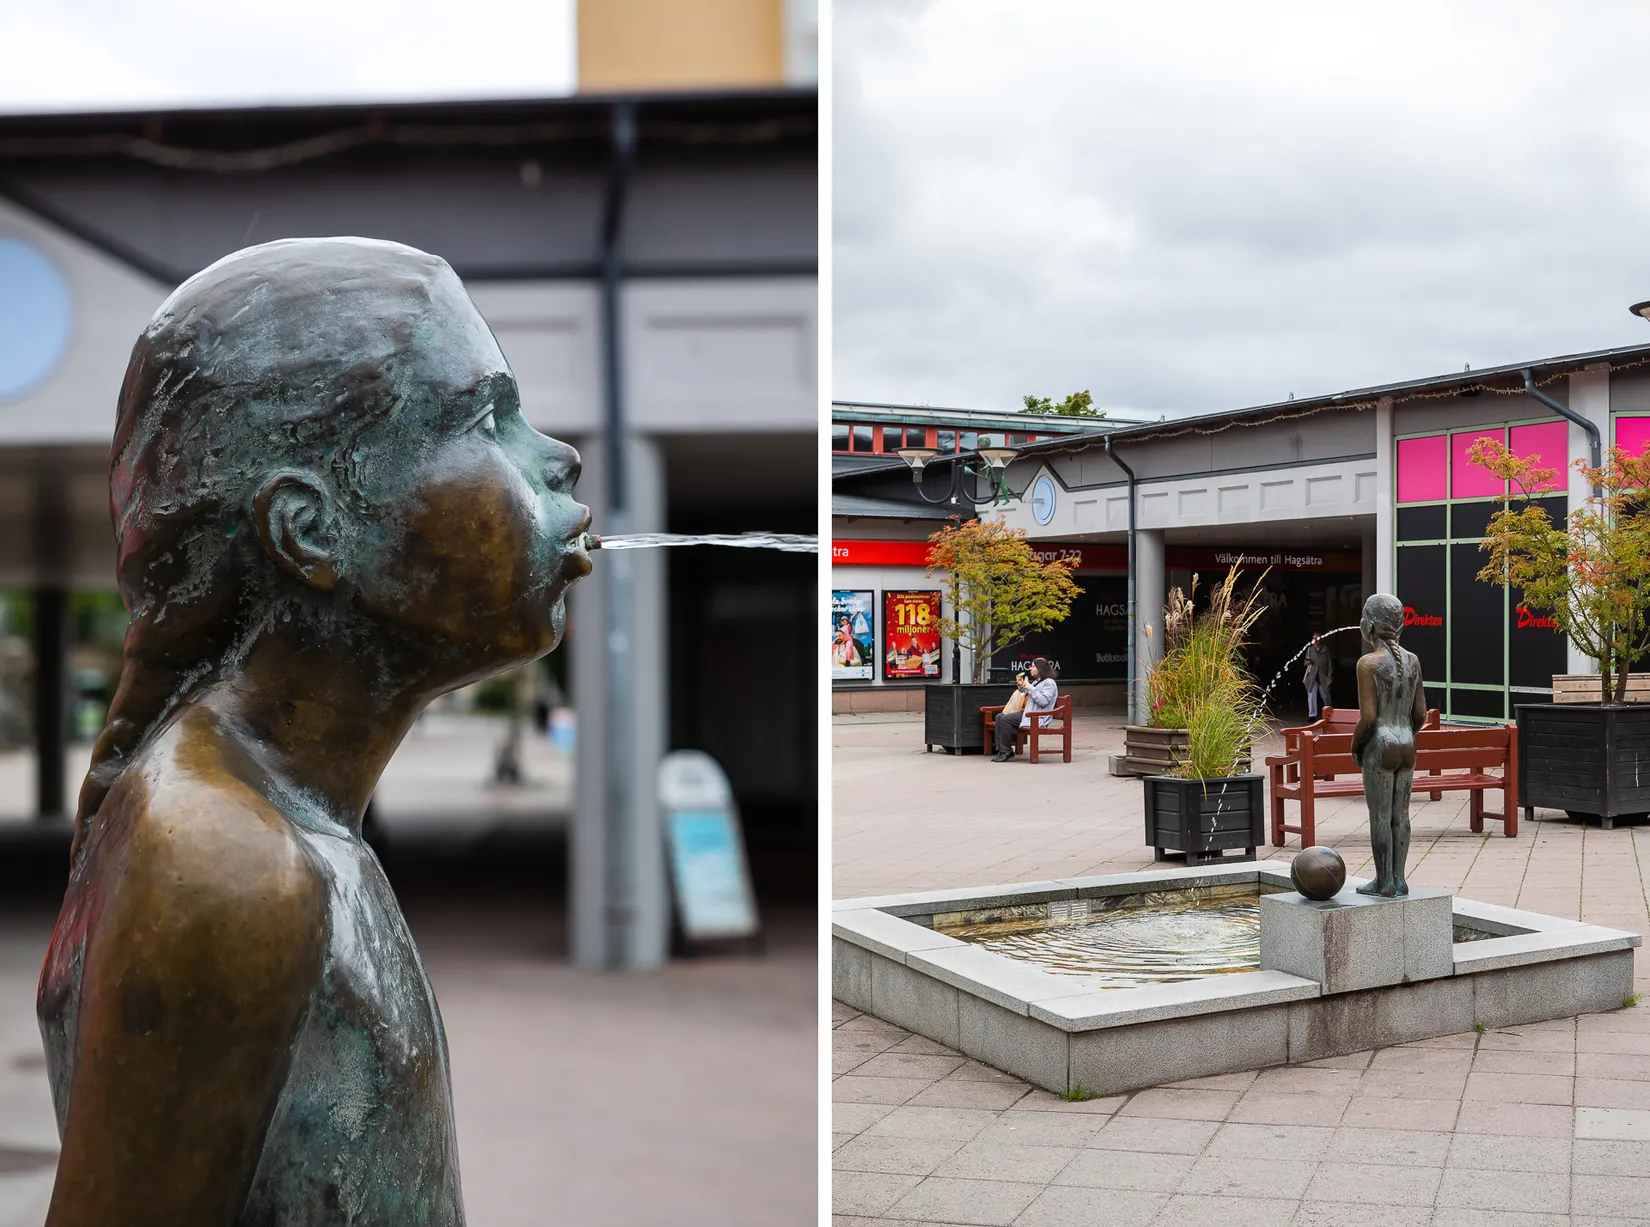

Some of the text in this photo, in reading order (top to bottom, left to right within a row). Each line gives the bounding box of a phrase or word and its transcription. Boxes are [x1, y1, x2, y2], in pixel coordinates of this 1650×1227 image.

[1029, 549, 1082, 563] agar 7-22
[1215, 553, 1323, 568] Välkommen till Hagsätra
[895, 603, 931, 625] 118
[1096, 604, 1128, 616] HAGS
[1403, 606, 1443, 627] Direkten
[1515, 607, 1561, 628] Direkte
[1011, 661, 1061, 671] HAGRA
